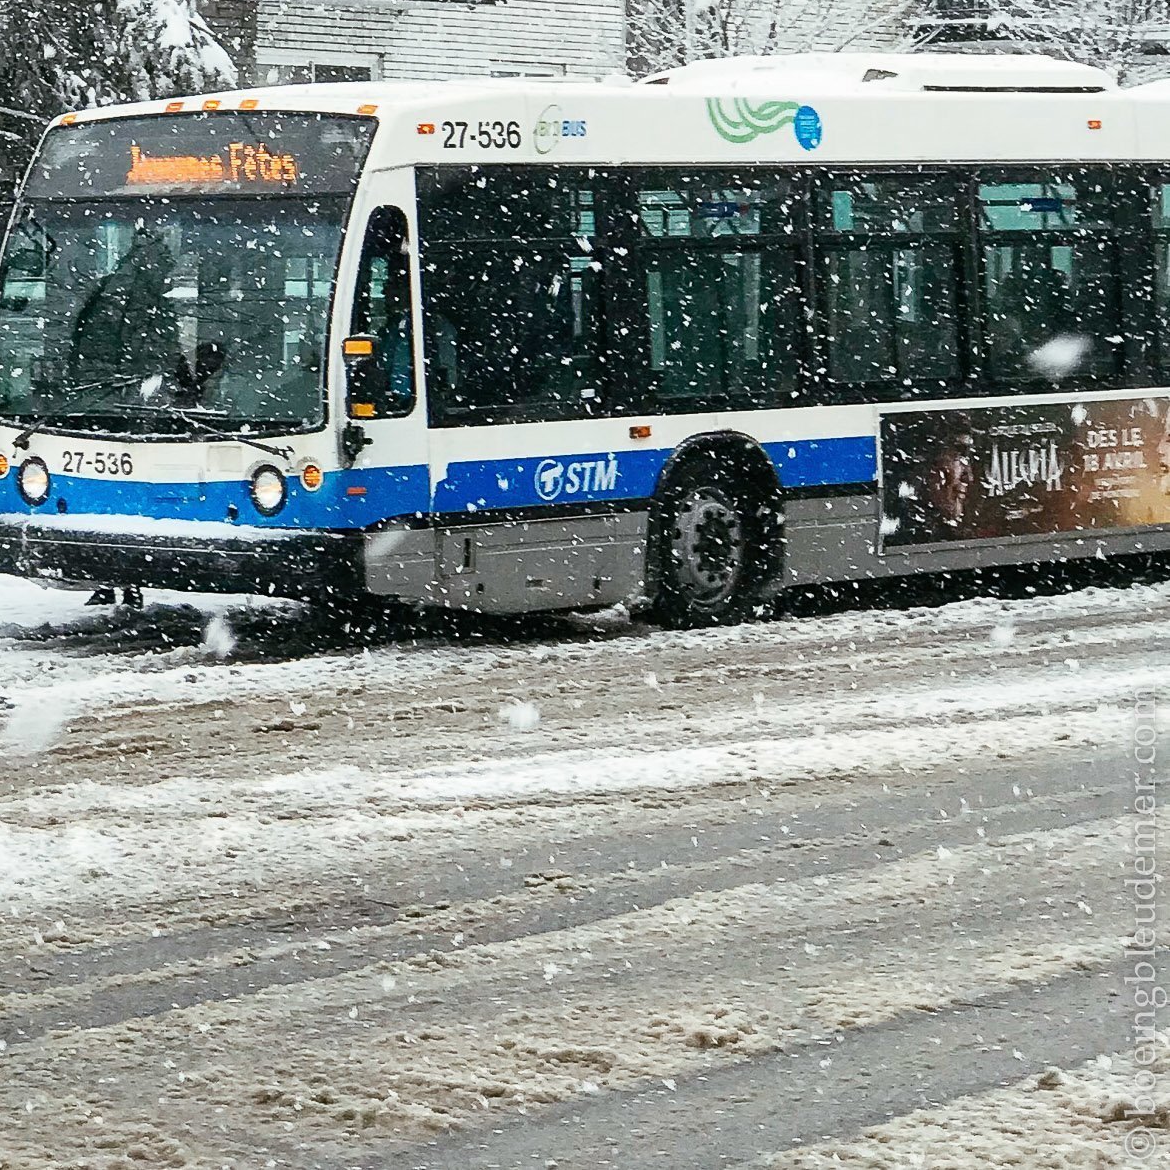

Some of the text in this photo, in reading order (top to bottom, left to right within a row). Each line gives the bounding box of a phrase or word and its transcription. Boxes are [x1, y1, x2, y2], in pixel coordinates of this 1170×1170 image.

[441, 120, 522, 149] 27-536
[1122, 427, 1145, 447] LE
[62, 450, 134, 476] 27-536
[565, 460, 618, 494] STM
